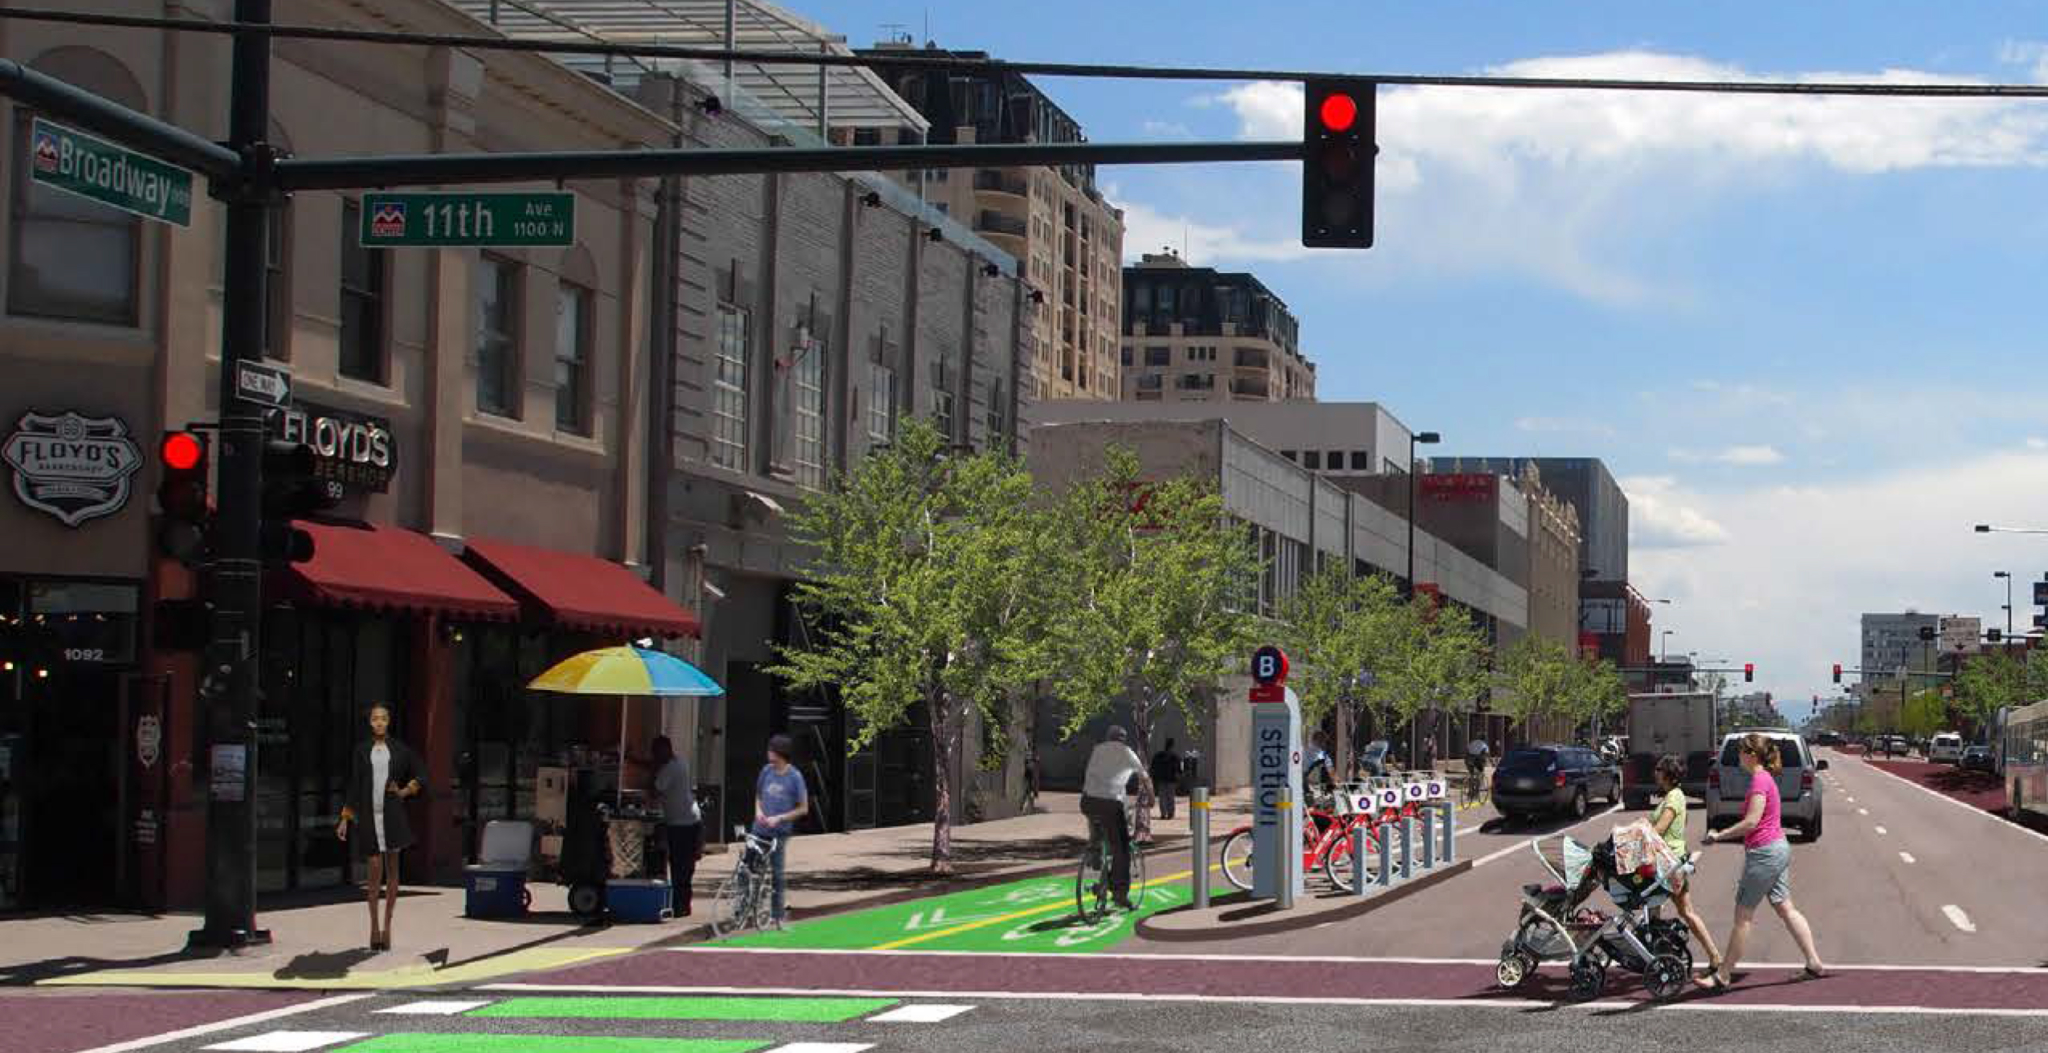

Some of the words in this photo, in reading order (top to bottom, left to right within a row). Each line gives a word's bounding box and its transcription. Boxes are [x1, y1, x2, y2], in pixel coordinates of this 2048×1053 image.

[60, 135, 171, 216] Broadway
[423, 201, 494, 238] 11th
[525, 202, 553, 217] Ave
[513, 222, 546, 237] 1100
[553, 222, 565, 237] N
[243, 372, 258, 390] ONE
[260, 377, 277, 394] WAY
[63, 648, 104, 662] 1092
[1259, 655, 1275, 678] B
[1258, 728, 1289, 826] station
